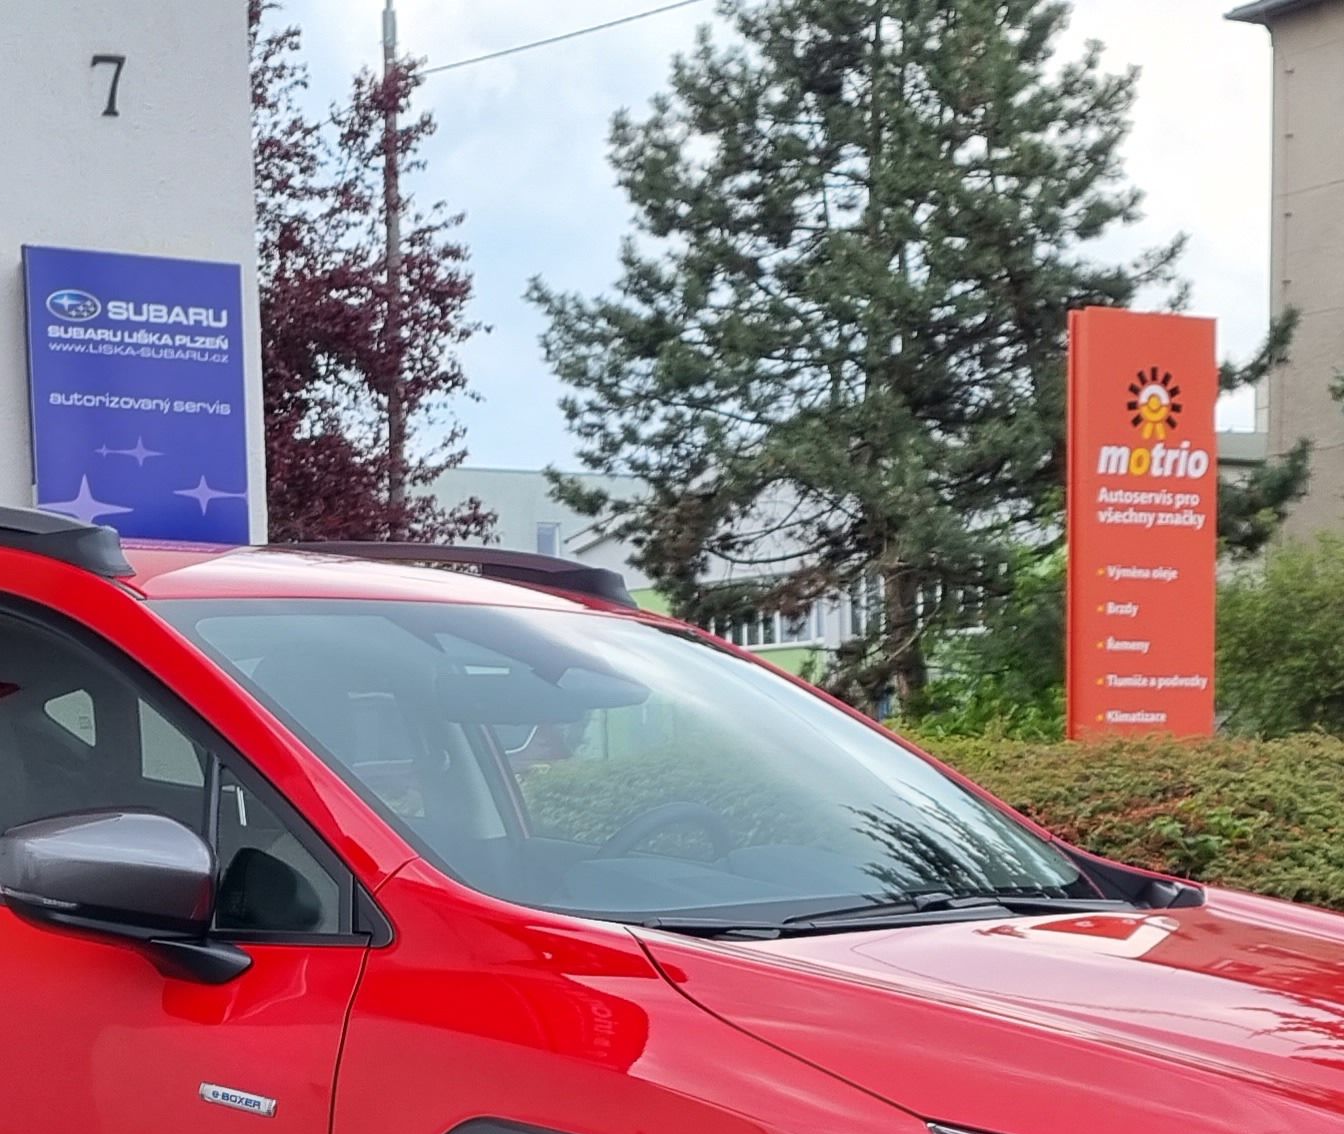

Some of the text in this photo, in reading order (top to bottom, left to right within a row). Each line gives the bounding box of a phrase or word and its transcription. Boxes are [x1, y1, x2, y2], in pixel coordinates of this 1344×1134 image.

[90, 54, 126, 117] 7
[107, 301, 228, 328] SUBARU
[48, 325, 228, 350] SUBARU LIŠKA PLZEŇ
[49, 392, 231, 415] autorizovaný servis
[1097, 440, 1209, 479] motrio
[1098, 487, 1200, 509] Autoservis pro
[1098, 507, 1206, 530] všechny značky
[1106, 601, 1139, 617] Brzdy
